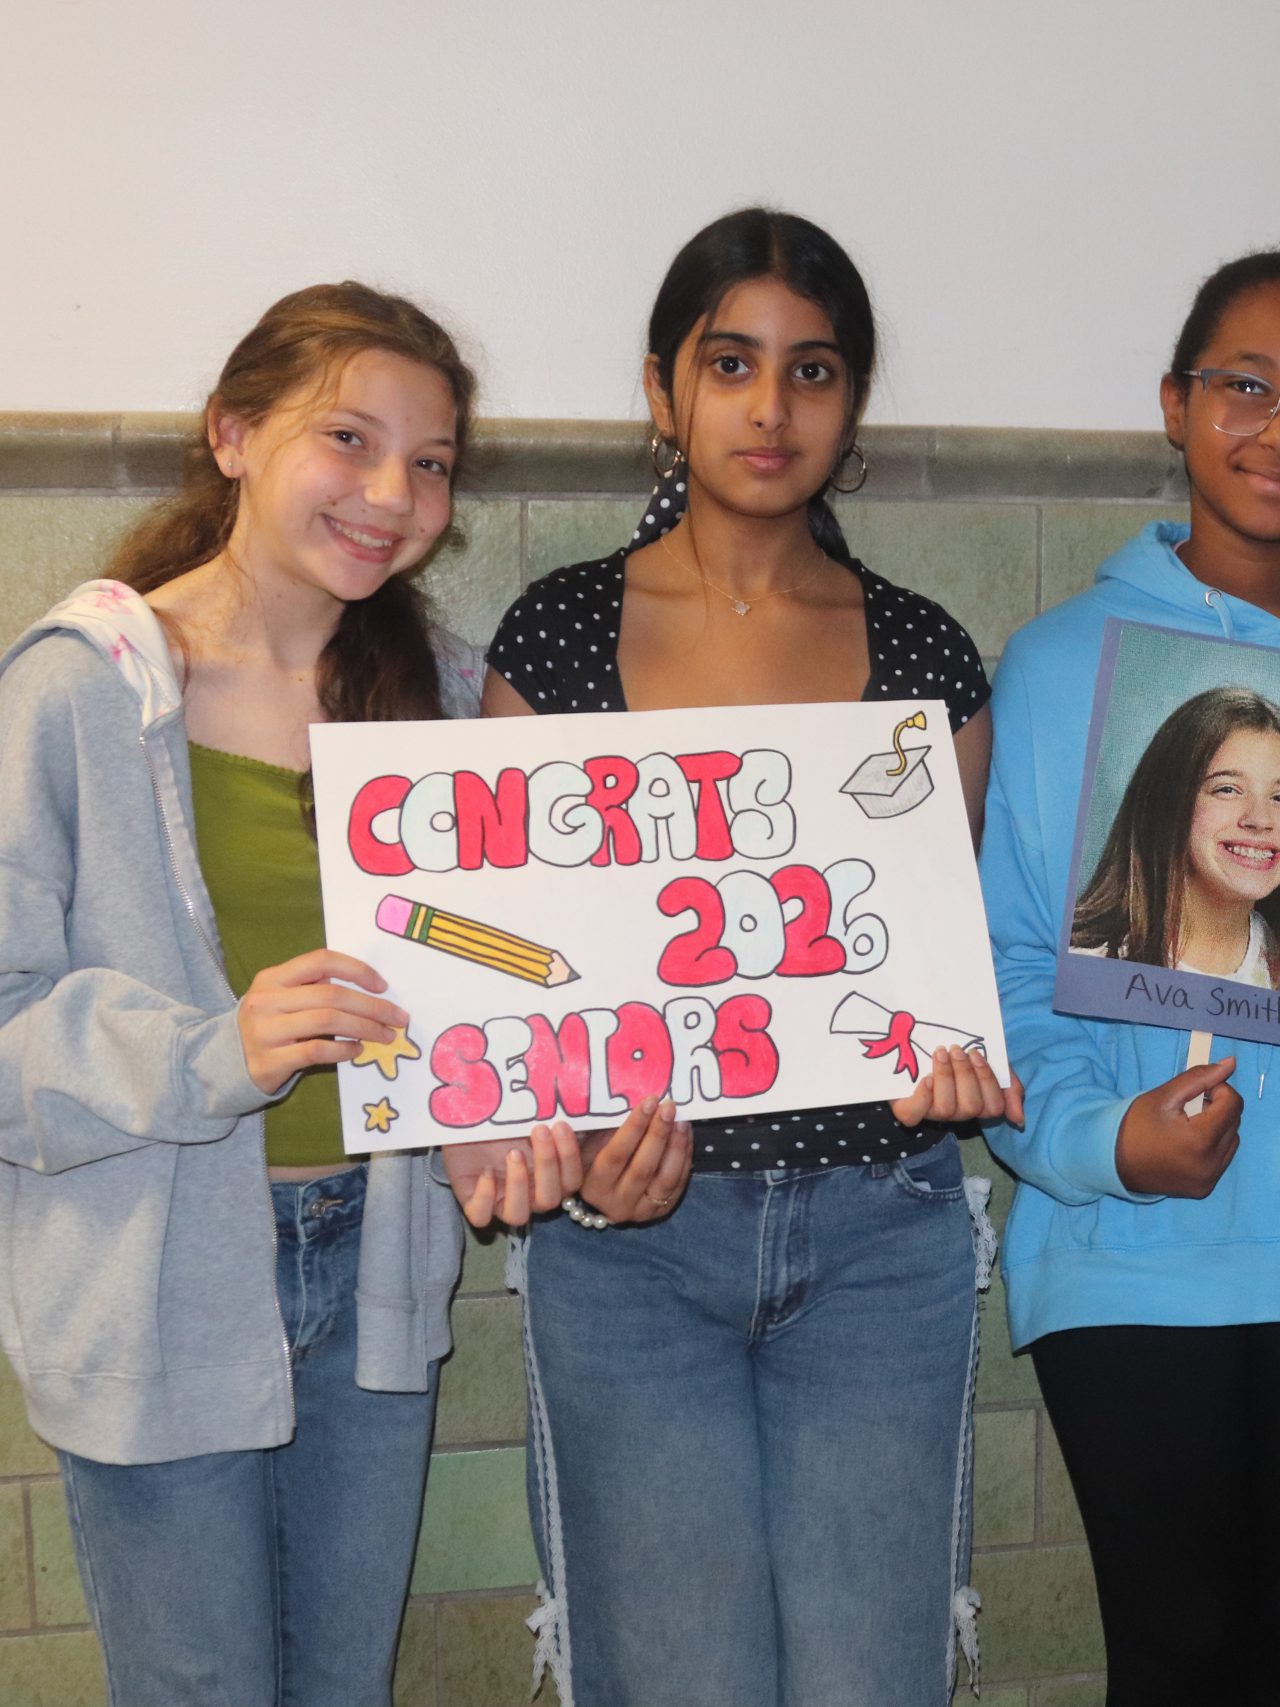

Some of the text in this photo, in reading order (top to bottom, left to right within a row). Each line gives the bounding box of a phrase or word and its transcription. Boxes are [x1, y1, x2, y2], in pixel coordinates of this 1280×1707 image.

[347, 749, 796, 875] CONGRATS
[657, 858, 889, 986] 2026
[1125, 973, 1193, 1007] Ava
[429, 994, 779, 1127] SENIORS
